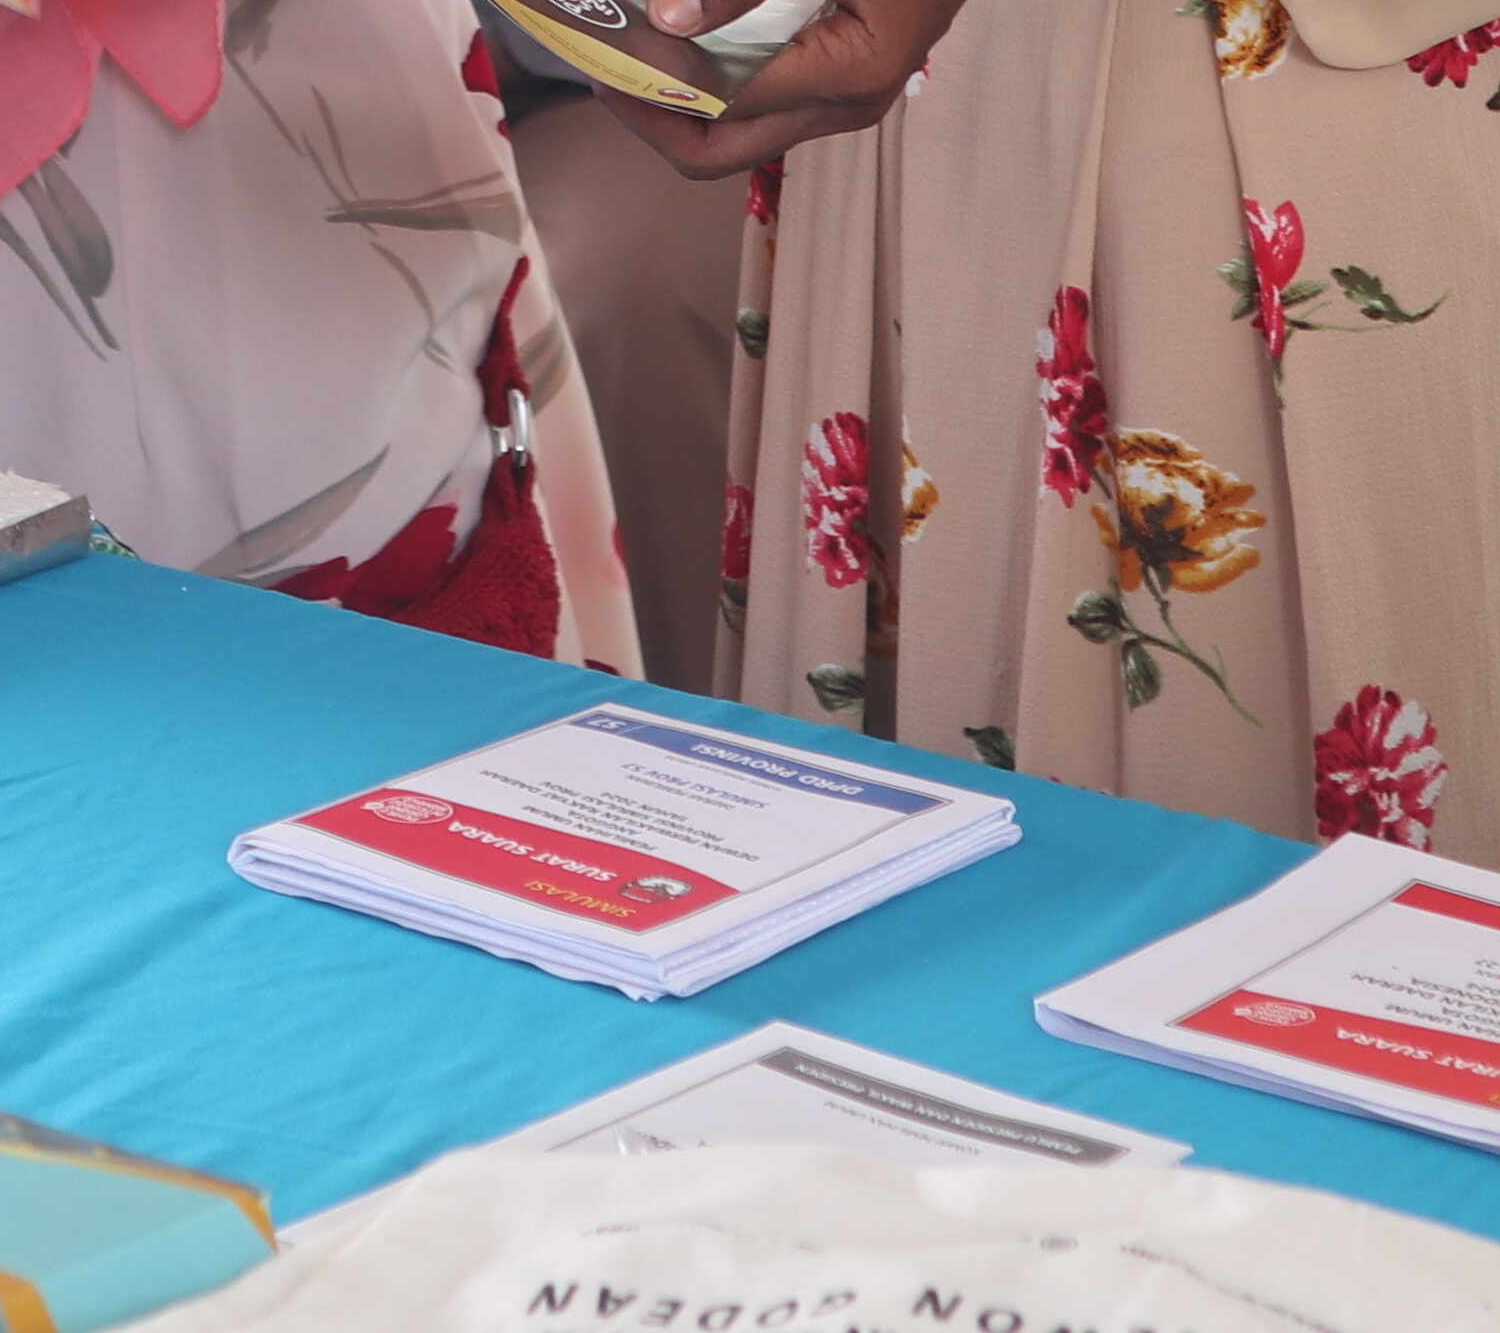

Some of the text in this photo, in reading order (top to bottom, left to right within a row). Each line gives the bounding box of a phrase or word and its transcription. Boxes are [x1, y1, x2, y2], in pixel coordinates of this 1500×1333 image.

[585, 717, 624, 731] 57
[687, 744, 798, 778] PROVINSI
[644, 768, 690, 788] PROV
[796, 775, 863, 796] DPRD
[692, 783, 768, 811] SIMULASI
[445, 820, 616, 882] SURAT SUARA
[522, 880, 635, 918] SIMULASI
[1334, 1028, 1432, 1061] SUARA
[526, 1282, 858, 1333] GODEAN
